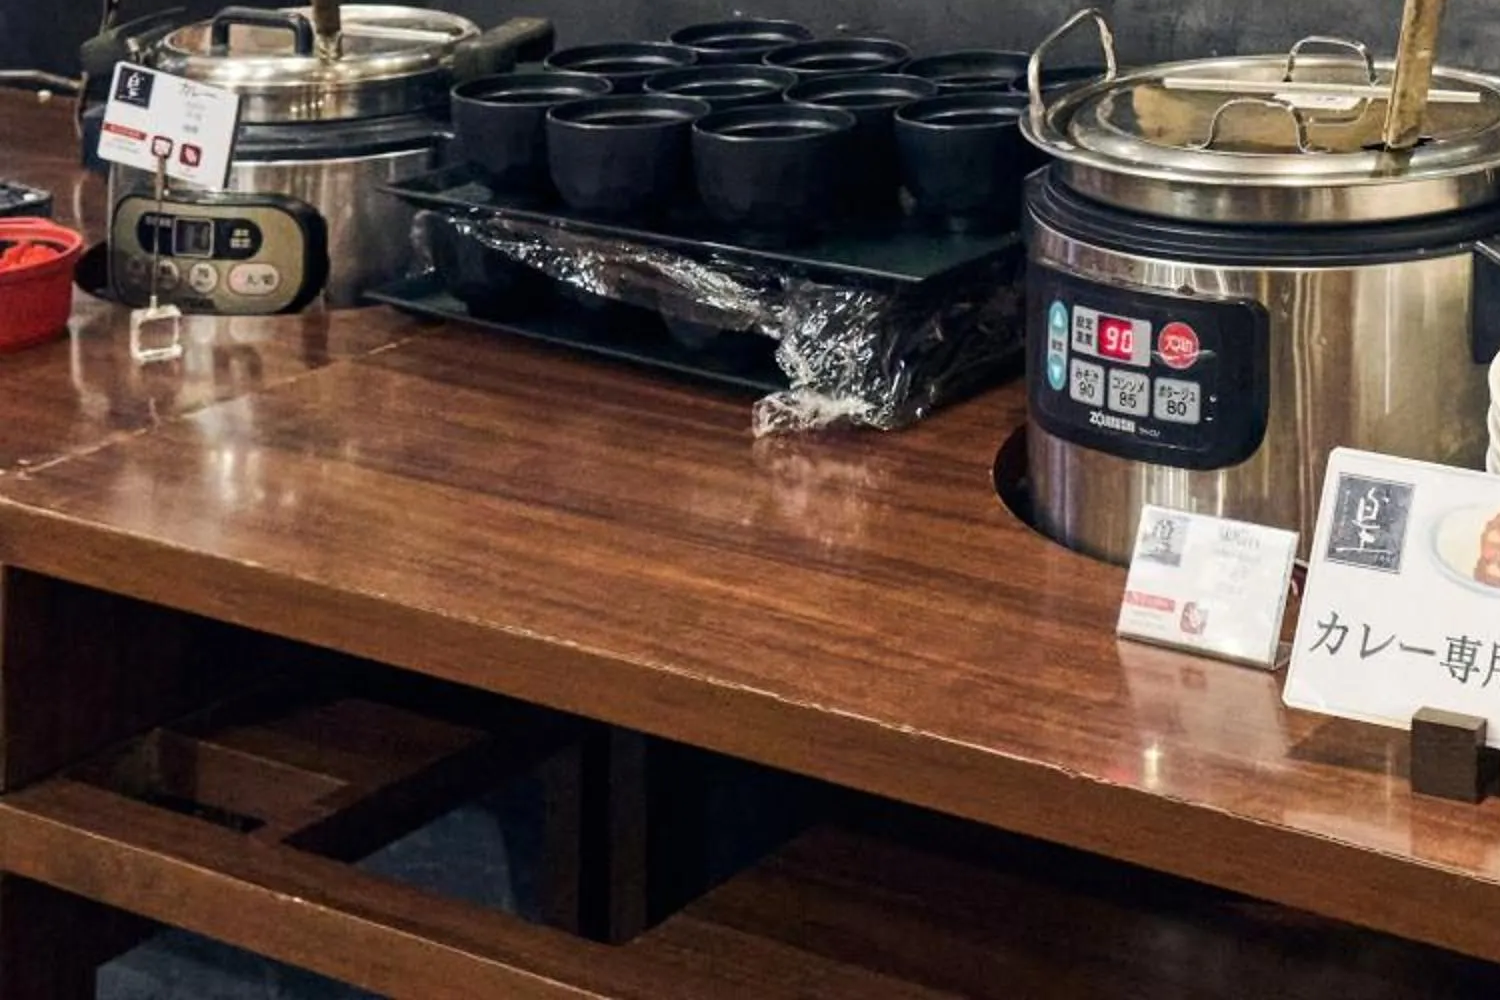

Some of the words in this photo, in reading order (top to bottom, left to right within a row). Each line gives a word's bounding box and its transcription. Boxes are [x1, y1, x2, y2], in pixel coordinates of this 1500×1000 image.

[1105, 326, 1133, 354] 90
[1078, 380, 1095, 399] 90
[1112, 376, 1145, 394] コンソメ
[1119, 391, 1137, 409] 85
[1167, 400, 1187, 417] 80
